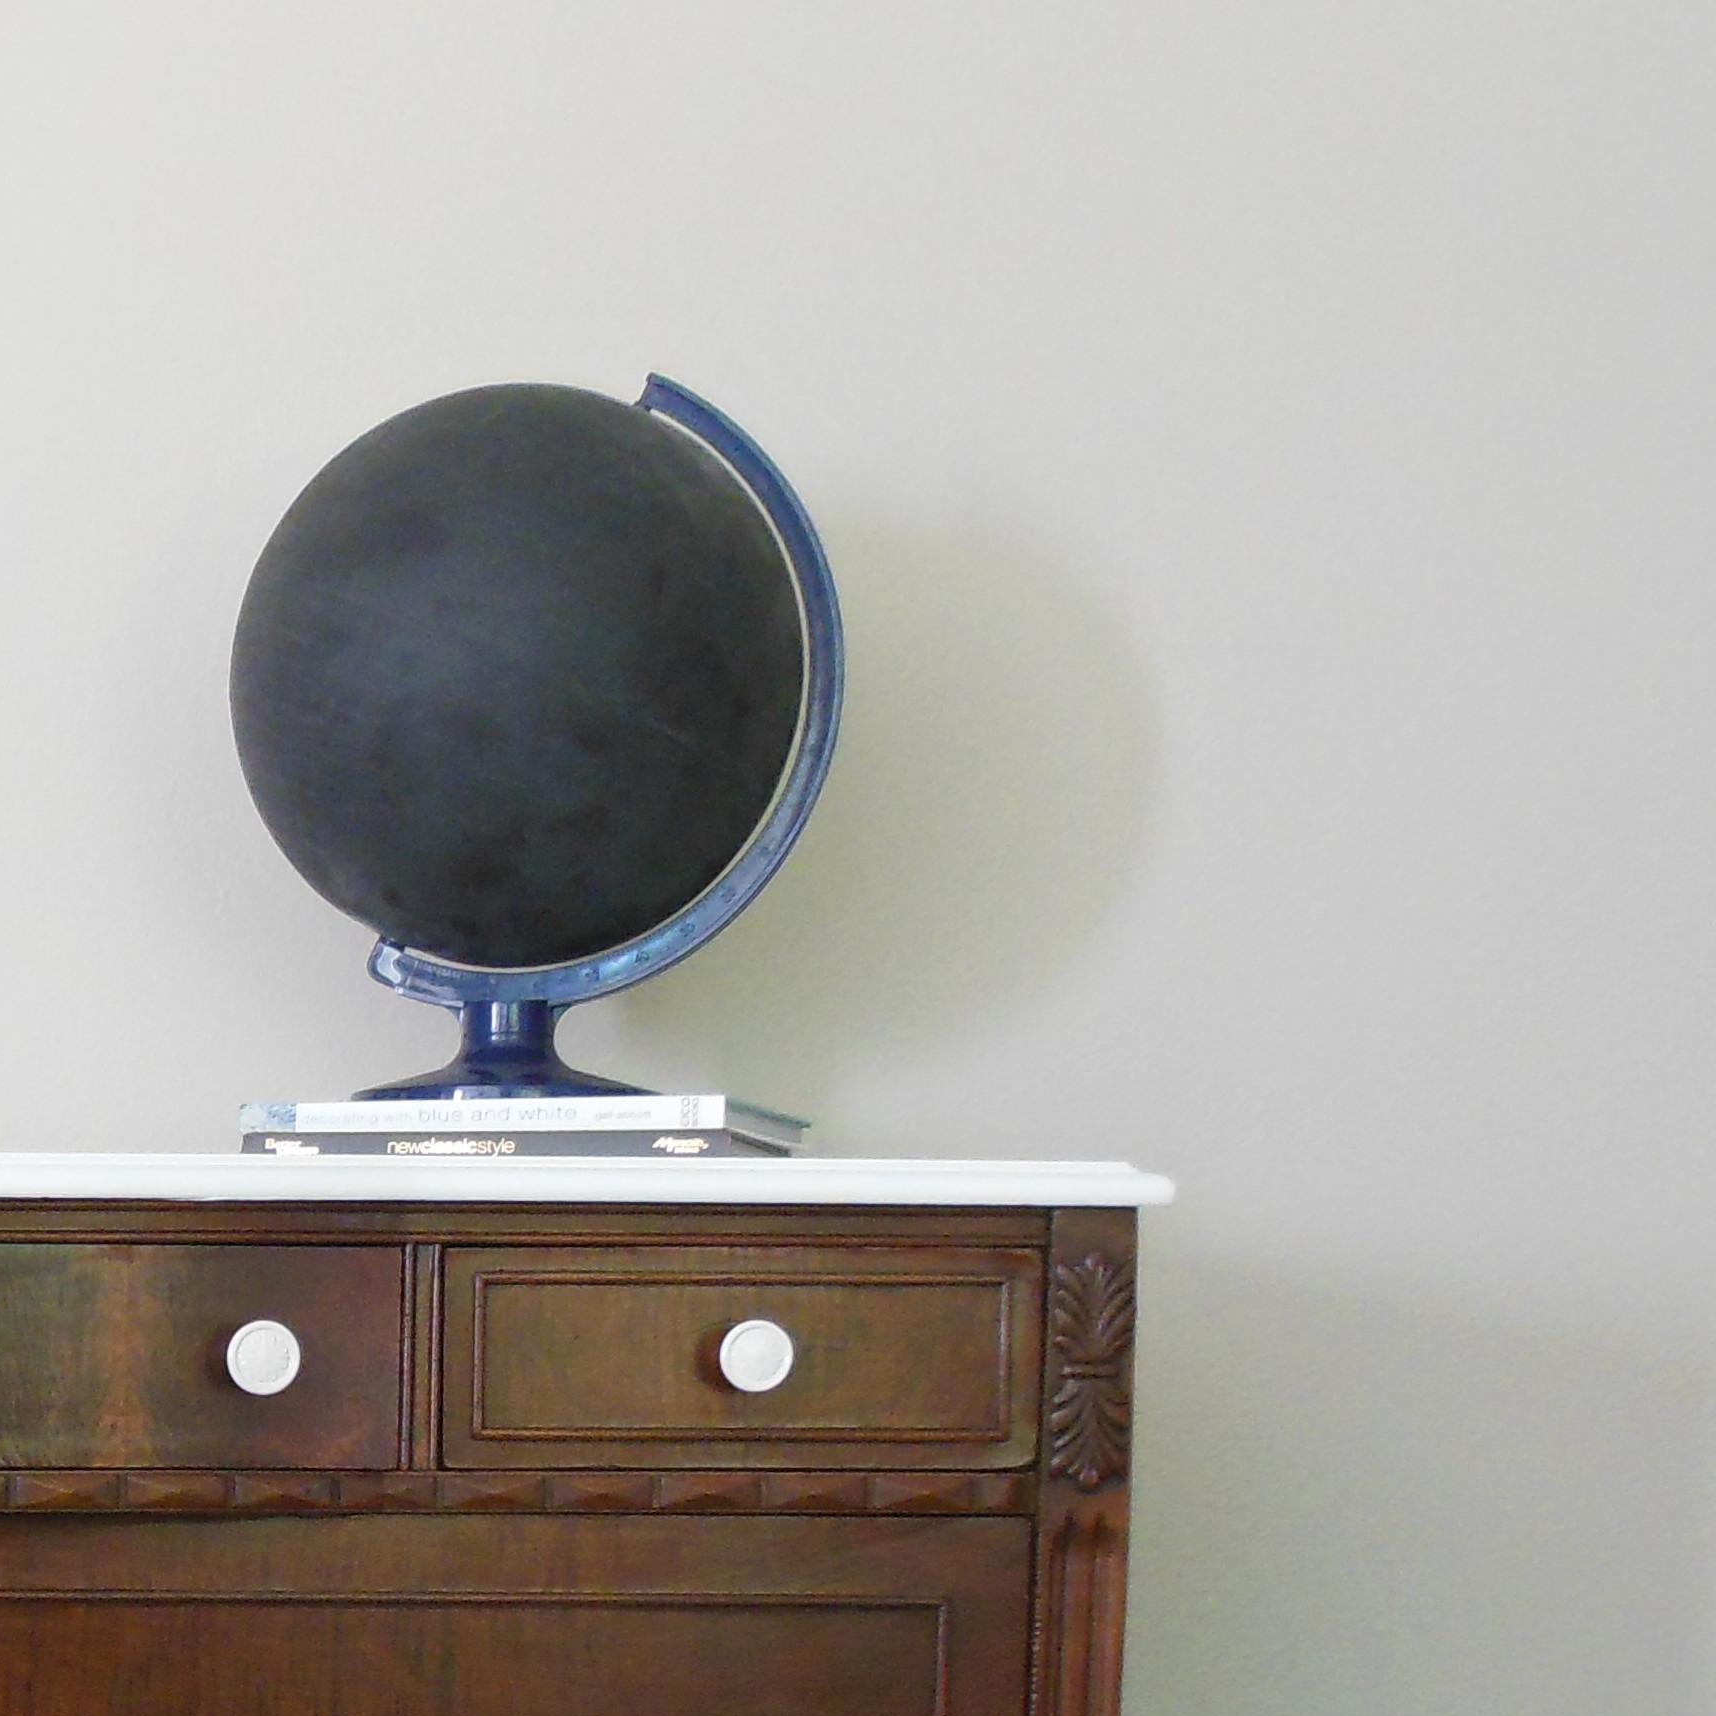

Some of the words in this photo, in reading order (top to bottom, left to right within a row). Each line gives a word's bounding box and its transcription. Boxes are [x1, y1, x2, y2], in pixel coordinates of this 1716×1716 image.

[418, 1108, 462, 1123] blue
[471, 1107, 511, 1122] and
[519, 1106, 577, 1121] white
